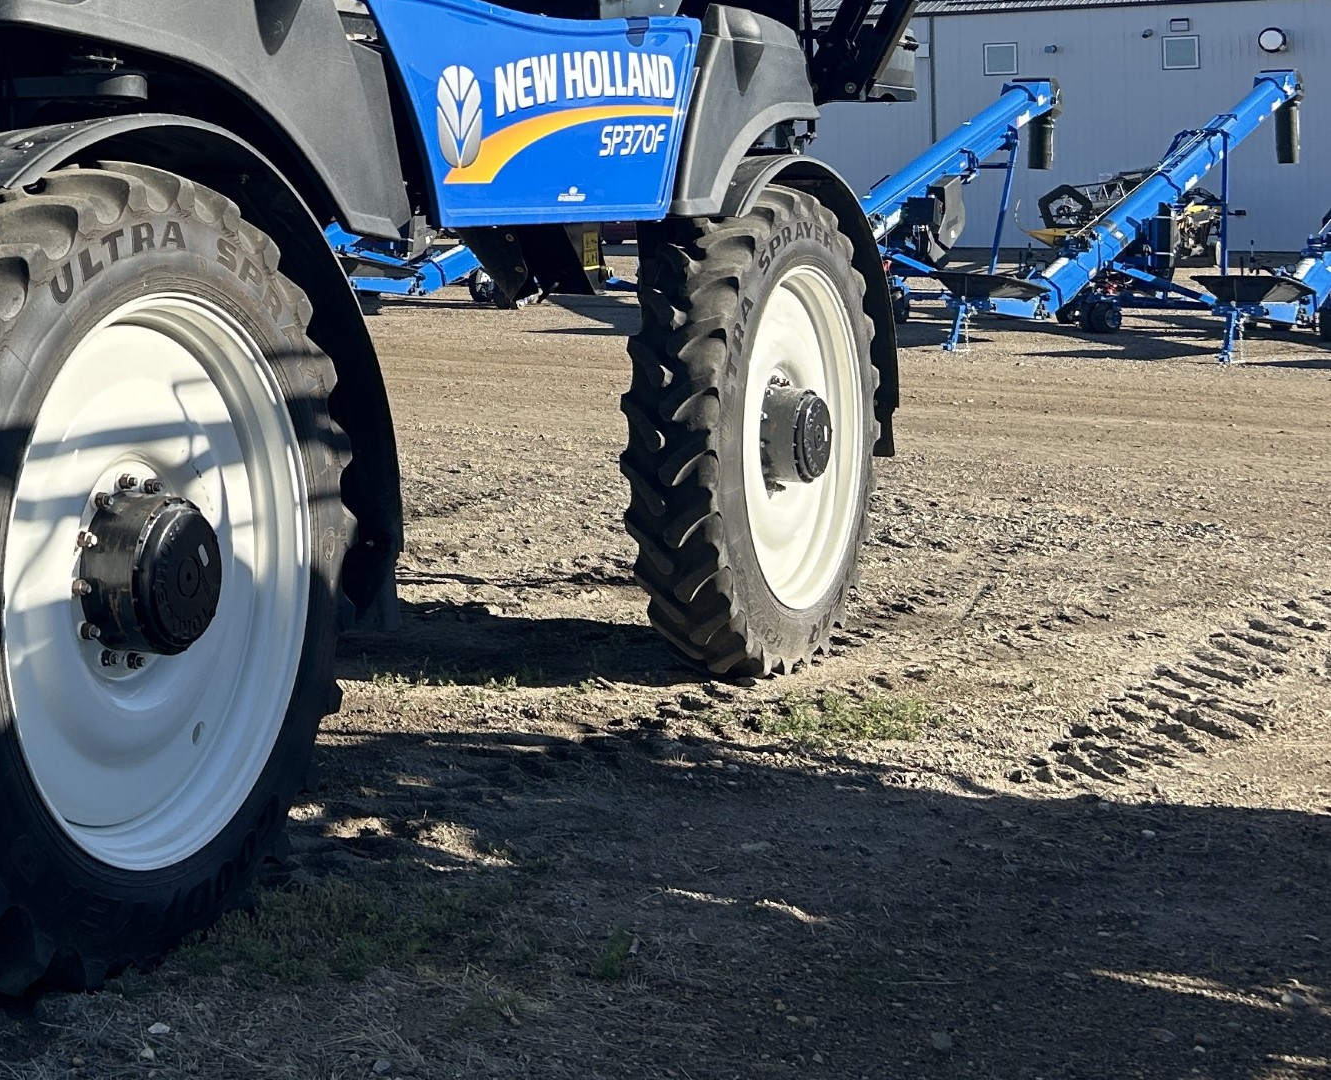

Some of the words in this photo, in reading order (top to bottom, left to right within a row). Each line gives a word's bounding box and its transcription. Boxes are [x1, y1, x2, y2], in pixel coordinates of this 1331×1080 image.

[493, 52, 558, 118] NEW
[561, 49, 675, 100] HOLLAND
[598, 123, 667, 157] SP370F
[49, 220, 187, 305] ULTRA
[756, 221, 835, 276] SPRAYER
